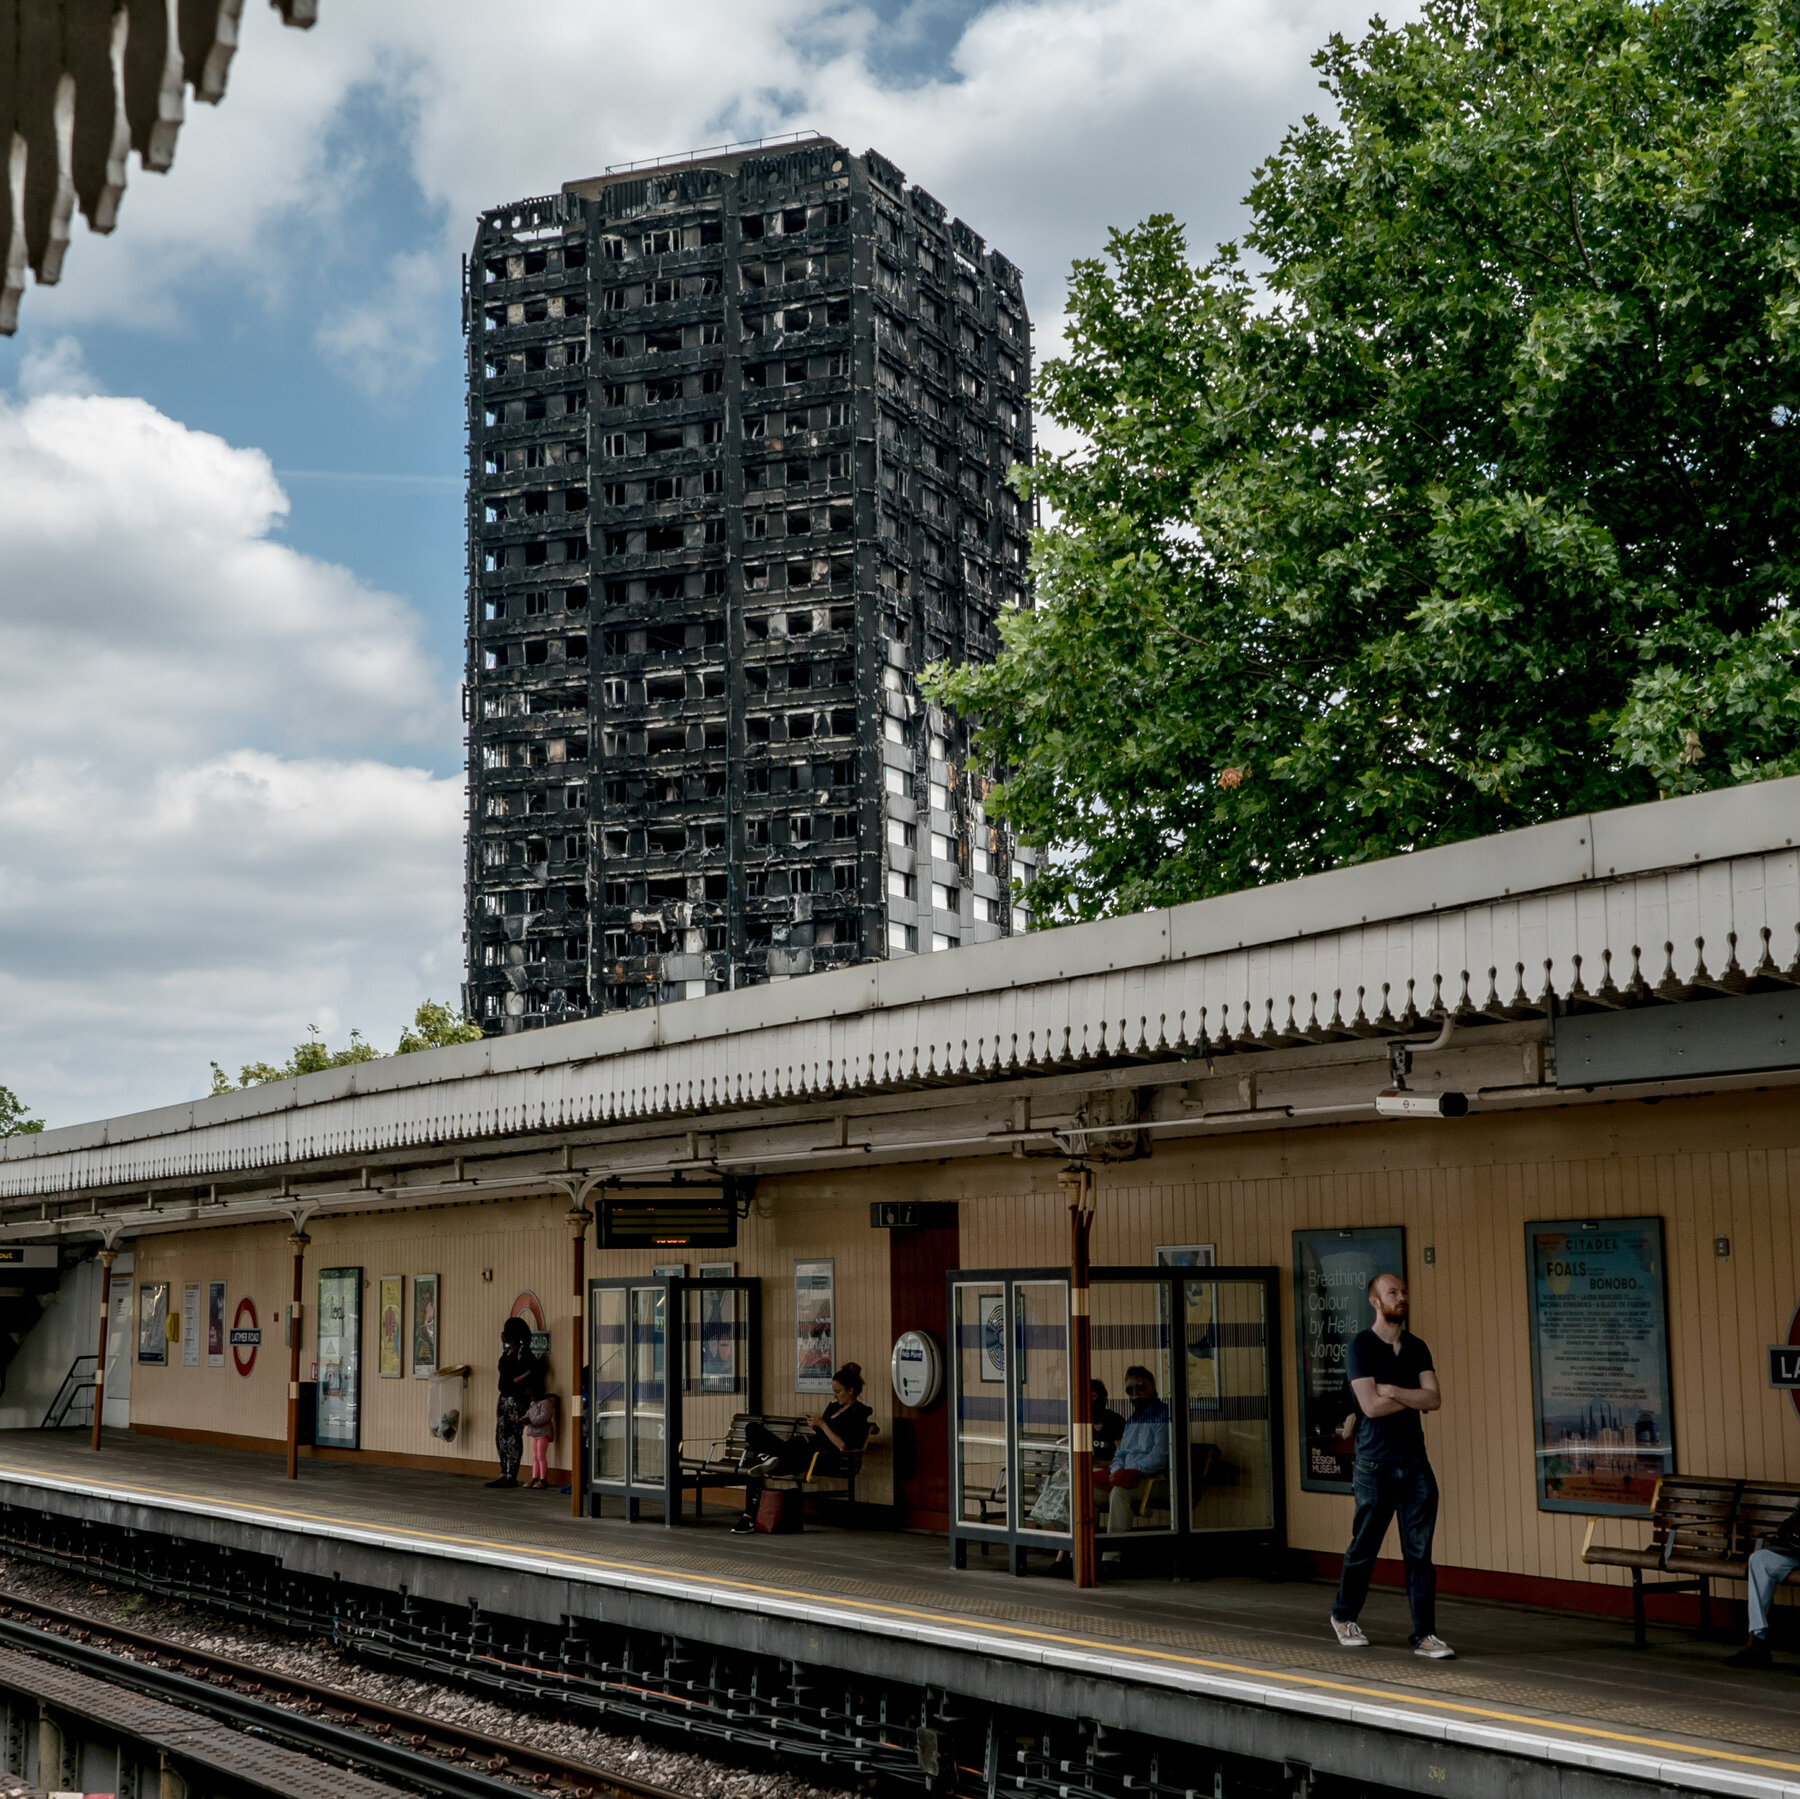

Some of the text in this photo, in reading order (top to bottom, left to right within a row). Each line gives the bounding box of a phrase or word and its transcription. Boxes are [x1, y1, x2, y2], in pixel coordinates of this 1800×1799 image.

[1566, 1239, 1618, 1250] CITADEL
[1547, 1262, 1586, 1276] FOALS
[1308, 1269, 1366, 1289] Breathing
[1590, 1278, 1637, 1290] BONOBO
[1308, 1292, 1349, 1311] Colour
[1309, 1315, 1359, 1338] by Hella
[231, 1332, 260, 1343] LATIMER ROAD
[1311, 1447, 1322, 1456] the
[1311, 1455, 1337, 1465] DESIGN
[1312, 1464, 1341, 1474] MUSEUM
